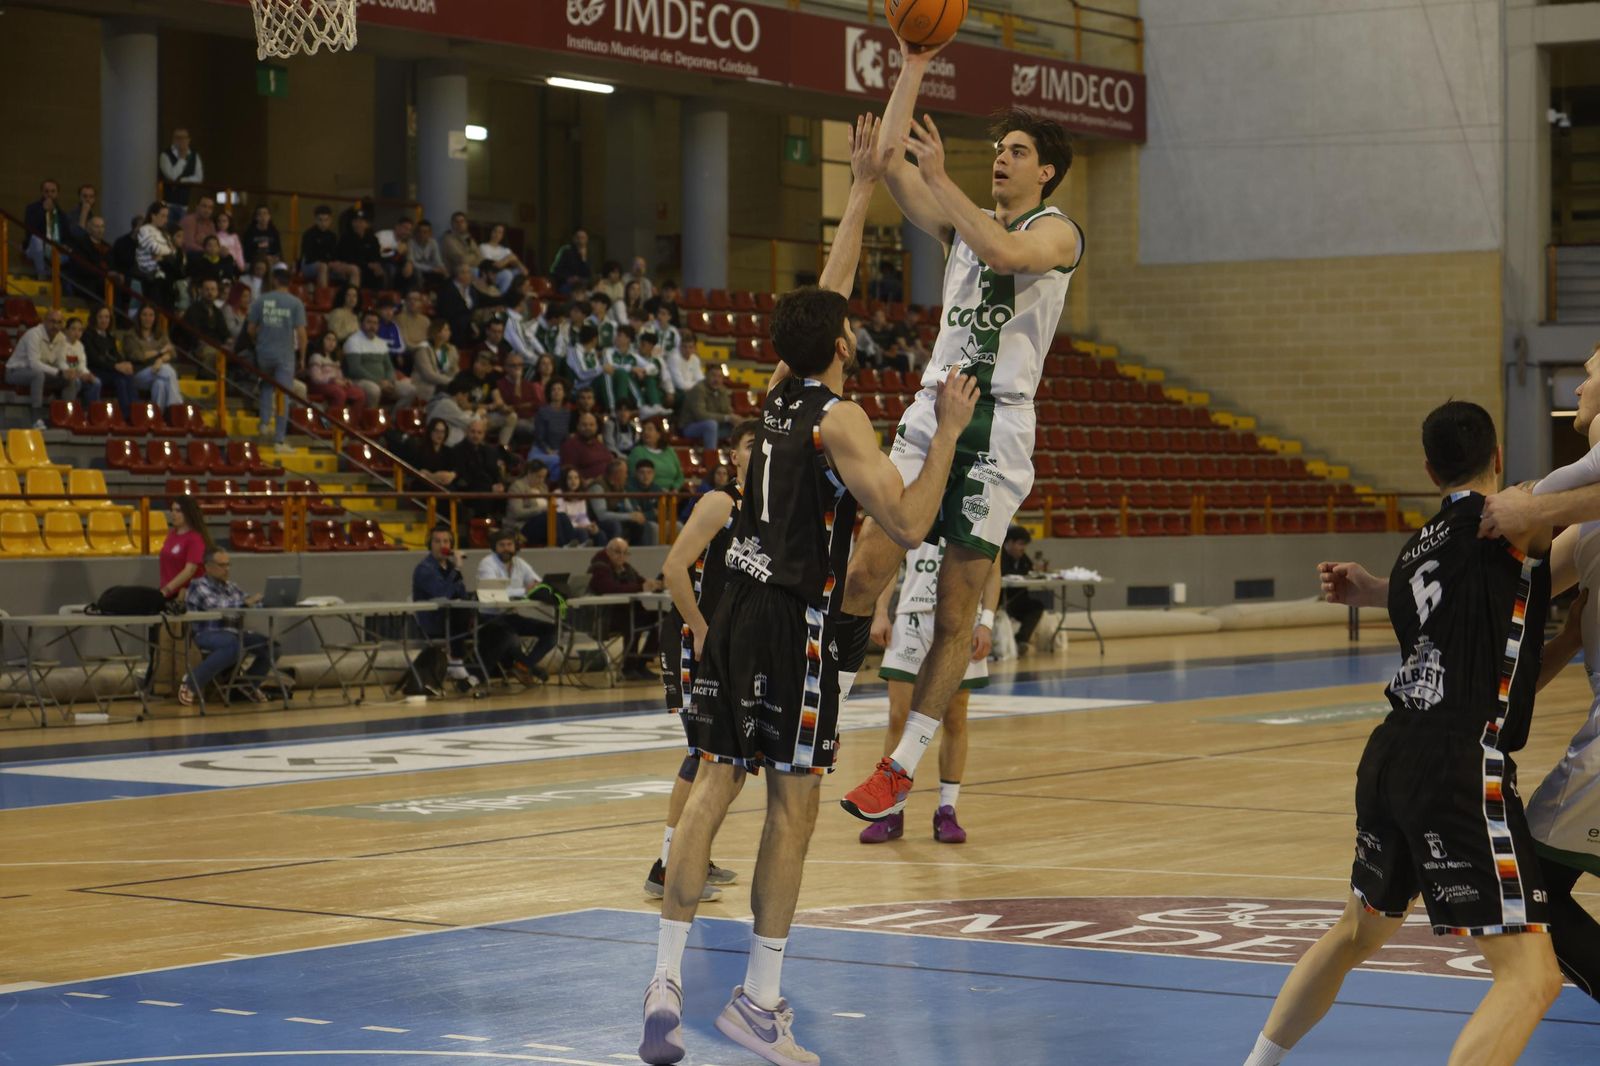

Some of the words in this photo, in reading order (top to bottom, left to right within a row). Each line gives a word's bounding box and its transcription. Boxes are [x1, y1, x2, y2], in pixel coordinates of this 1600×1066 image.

[614, 0, 760, 52] IMDECO
[567, 34, 609, 53] Instituto
[610, 42, 659, 63] Municipal
[660, 51, 673, 63] de
[675, 51, 718, 70] Deportes
[1041, 65, 1135, 114] IMDECO
[792, 139, 803, 160] J
[946, 302, 1014, 331] coto
[761, 438, 773, 524] 1
